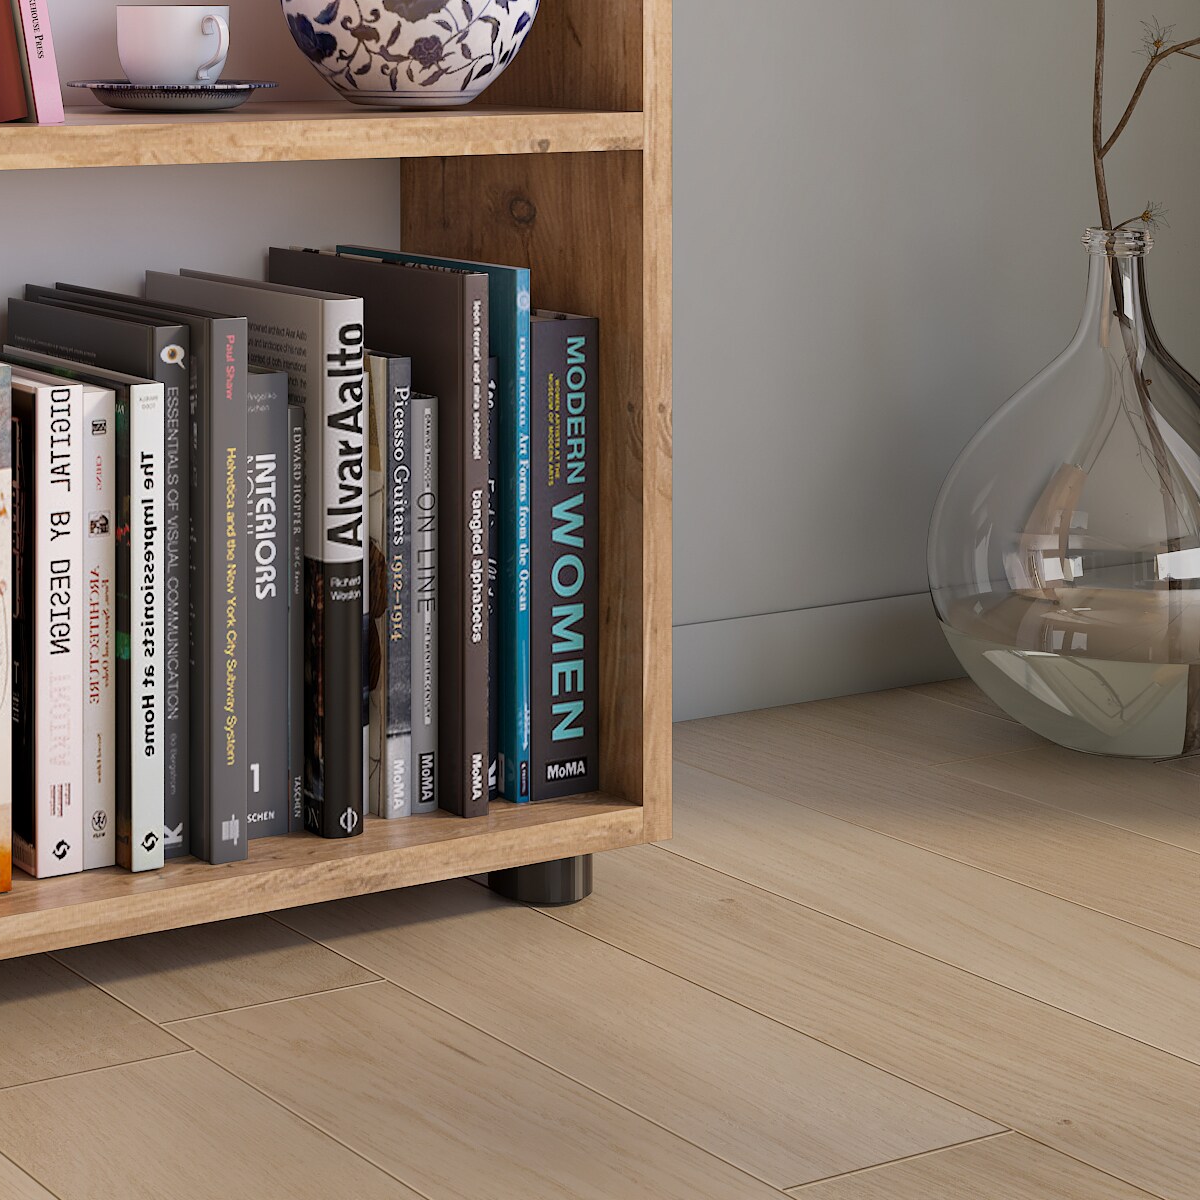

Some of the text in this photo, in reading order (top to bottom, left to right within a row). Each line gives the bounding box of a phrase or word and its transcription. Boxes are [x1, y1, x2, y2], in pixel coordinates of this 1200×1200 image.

[226, 334, 235, 400] Paul Shaw
[472, 326, 482, 360] ferrari
[472, 362, 482, 384] and
[472, 385, 482, 410] mira
[327, 322, 364, 548] Alvar Aalto
[392, 384, 410, 462] Picasso
[472, 412, 482, 460] schendel
[519, 432, 529, 455] Art
[293, 426, 302, 480] EDWARD
[519, 459, 529, 502] Forms
[255, 454, 277, 600] INTERIORS
[293, 483, 302, 535] HOPPER
[392, 465, 410, 546] Guitars
[417, 492, 436, 534] ON
[519, 506, 530, 540] from
[167, 386, 180, 720] ESSENTIALS OF VISUAL COMMUNICATION
[519, 543, 530, 565] the
[552, 336, 586, 742] MODERN WOMEN
[417, 548, 436, 614] LINE
[468, 489, 484, 643] tangled alphabets
[224, 447, 238, 766] Helvetica and the New York City Subway System
[519, 569, 530, 612] Ocean
[250, 762, 260, 793] 1
[393, 759, 405, 810] MoMA
[421, 754, 434, 801] MoMA
[472, 753, 484, 801] MoMA
[546, 760, 586, 780] MoMA
[247, 810, 276, 824] SCHEN
[294, 776, 302, 818] TASCHEN
